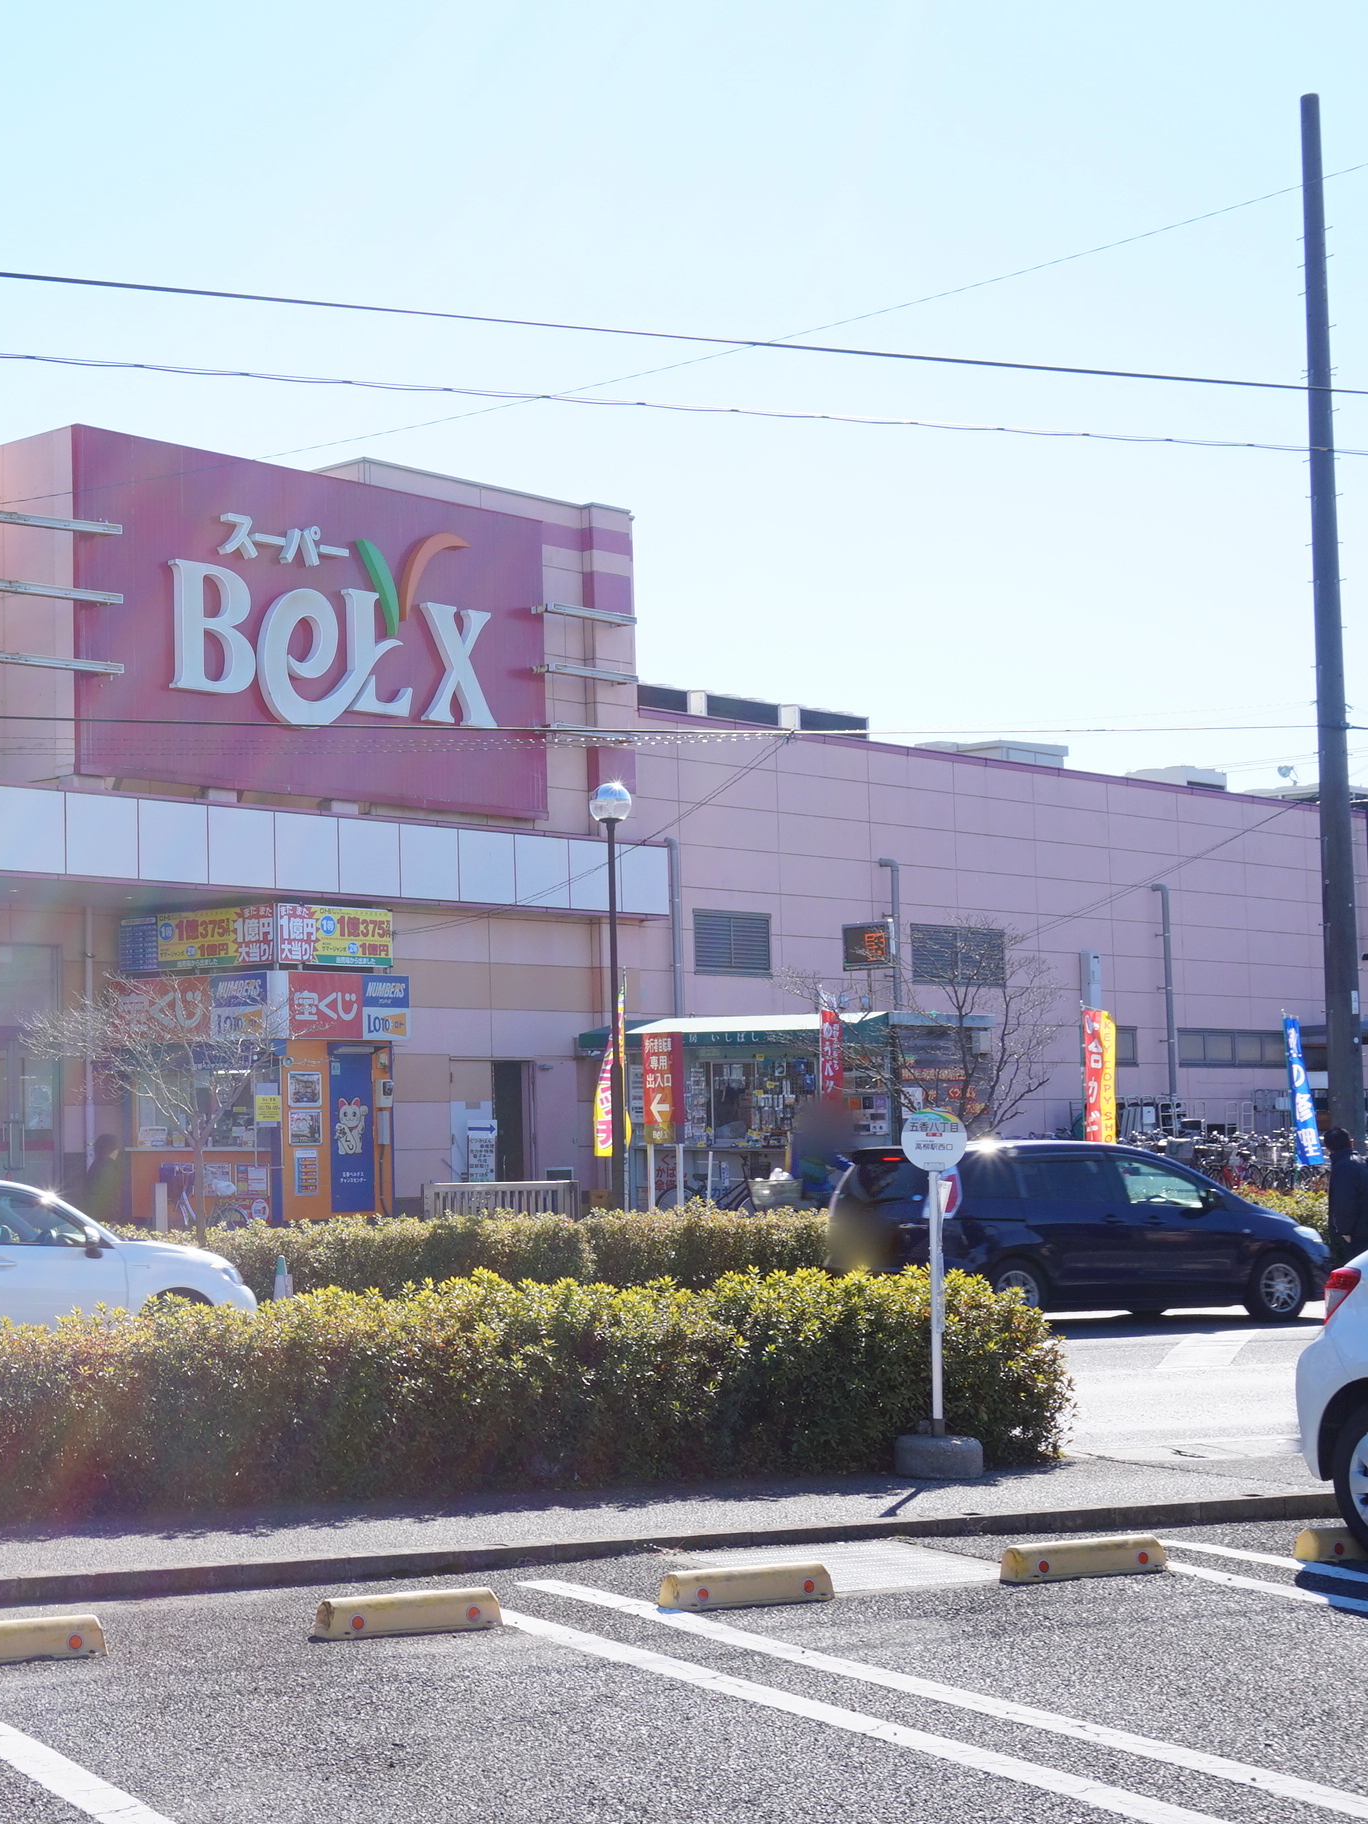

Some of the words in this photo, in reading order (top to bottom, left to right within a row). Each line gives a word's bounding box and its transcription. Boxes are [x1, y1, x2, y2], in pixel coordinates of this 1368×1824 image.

[217, 512, 350, 567] スーパー
[280, 906, 293, 916] また
[295, 907, 309, 917] また
[234, 917, 274, 942] 1億円
[280, 916, 317, 940] 1億円
[216, 980, 262, 999] NUMBERS
[366, 982, 405, 998] NUMBERS
[294, 990, 358, 1020] 宝くじ
[367, 1014, 390, 1034] LOTO
[1103, 1021, 1112, 1054] KEY
[650, 1055, 668, 1070] 専用
[646, 1073, 672, 1088] 出入口
[1102, 1061, 1112, 1105] COPY
[909, 1122, 959, 1132] 五香八丁目
[915, 1143, 953, 1151] 高柳駅西口
